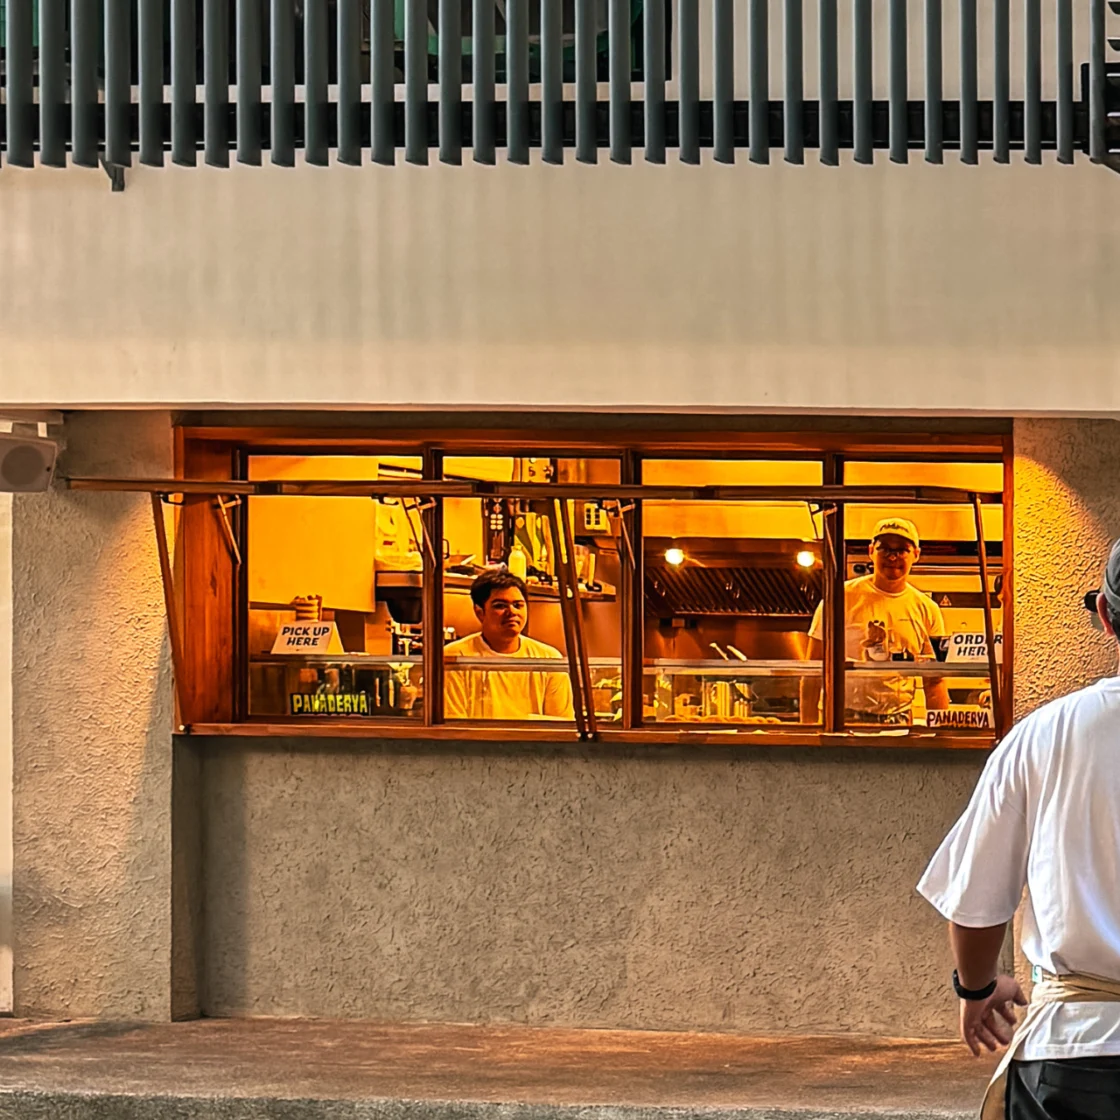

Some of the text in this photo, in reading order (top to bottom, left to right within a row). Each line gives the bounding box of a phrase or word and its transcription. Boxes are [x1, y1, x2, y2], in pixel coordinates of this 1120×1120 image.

[282, 626, 330, 636] PICK UP
[286, 637, 319, 646] HERE
[954, 634, 1003, 644] ORDR
[957, 646, 986, 656] HER
